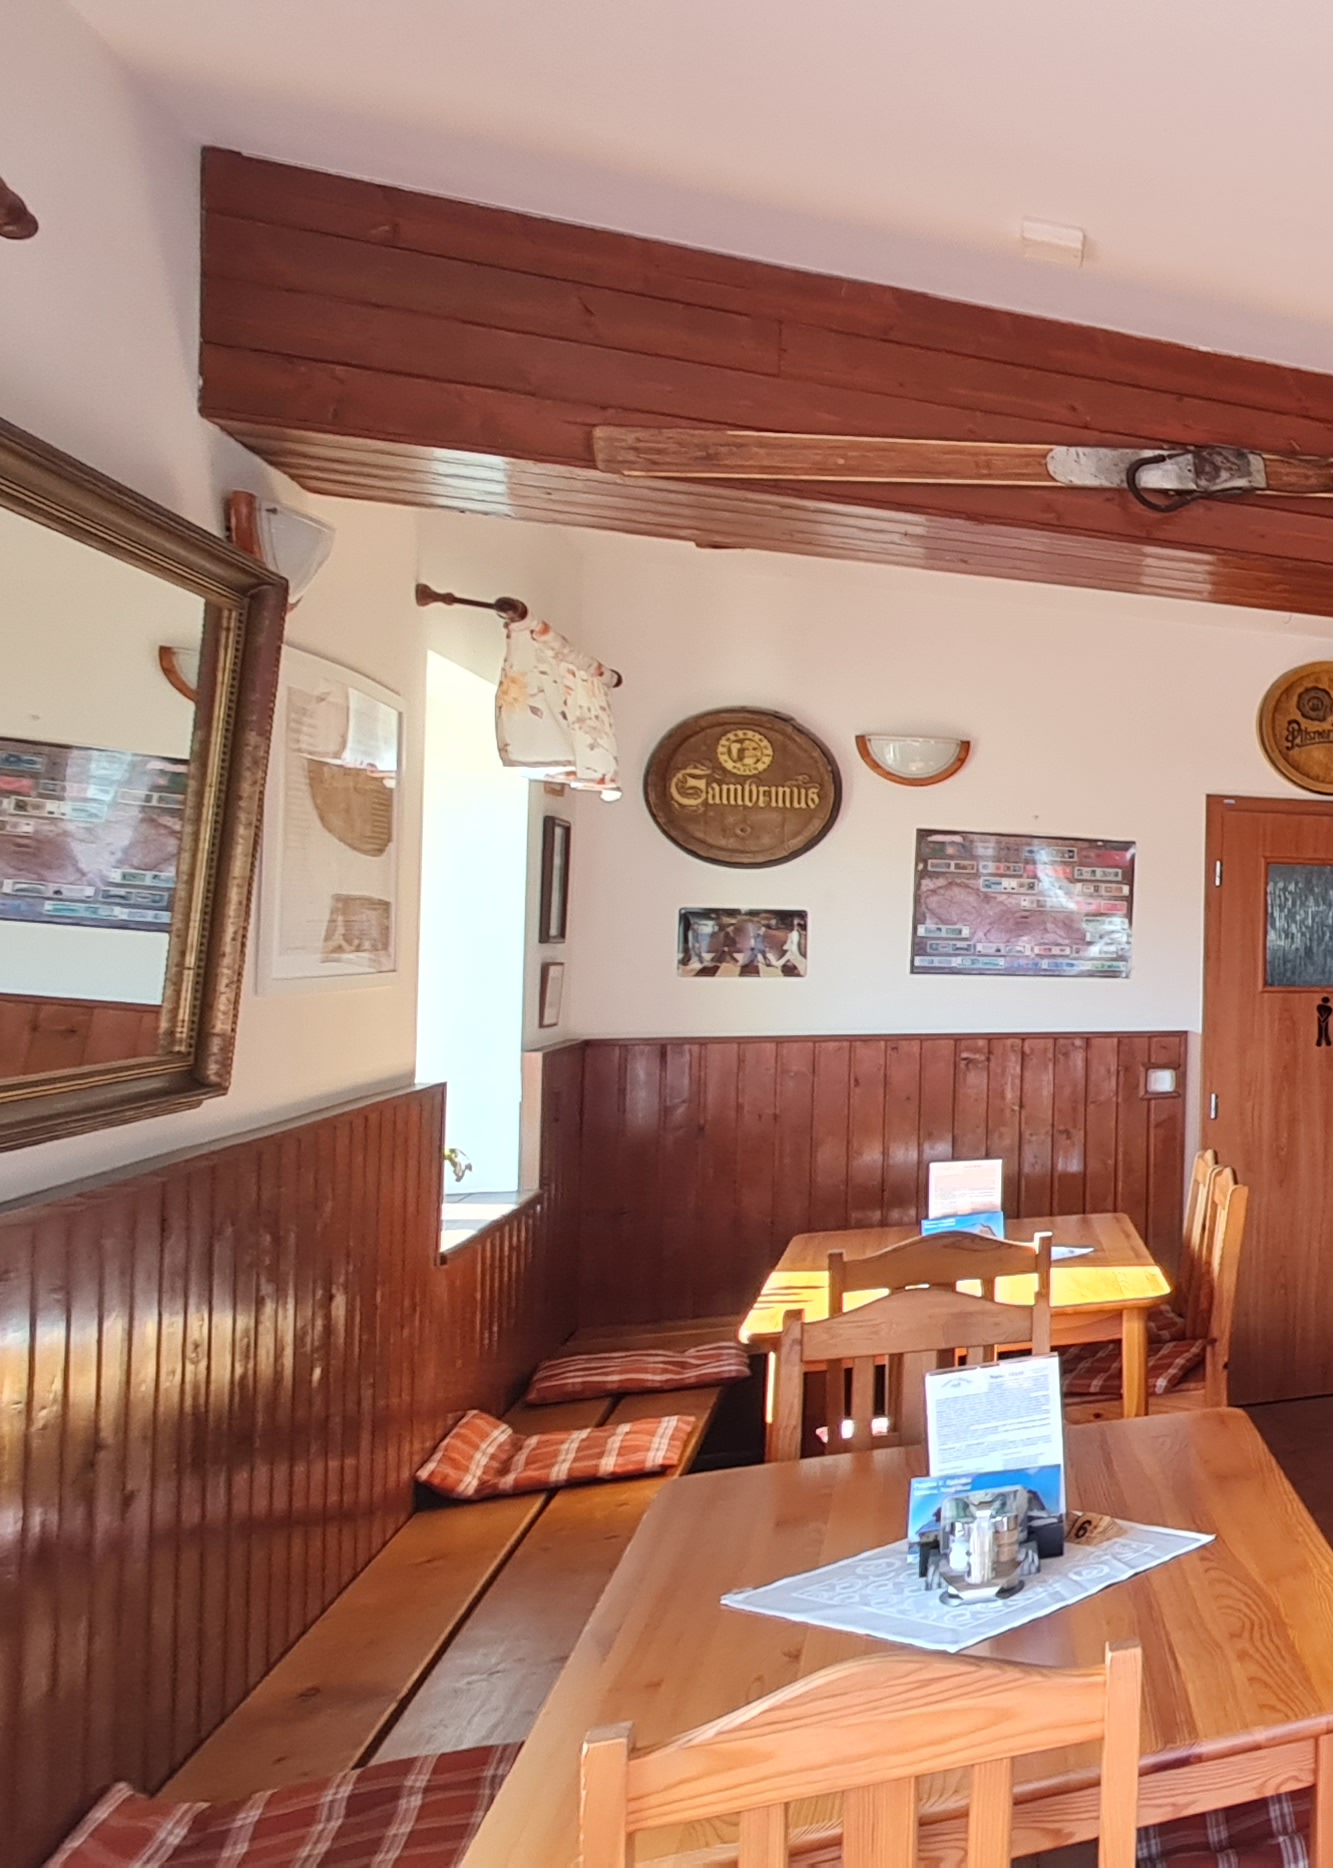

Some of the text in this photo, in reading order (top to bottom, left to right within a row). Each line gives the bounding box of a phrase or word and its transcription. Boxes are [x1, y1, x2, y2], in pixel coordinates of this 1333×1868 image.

[1284, 719, 1332, 751] Pilsner
[669, 763, 820, 812] Gambrinus
[1075, 1519, 1092, 1539] 6
